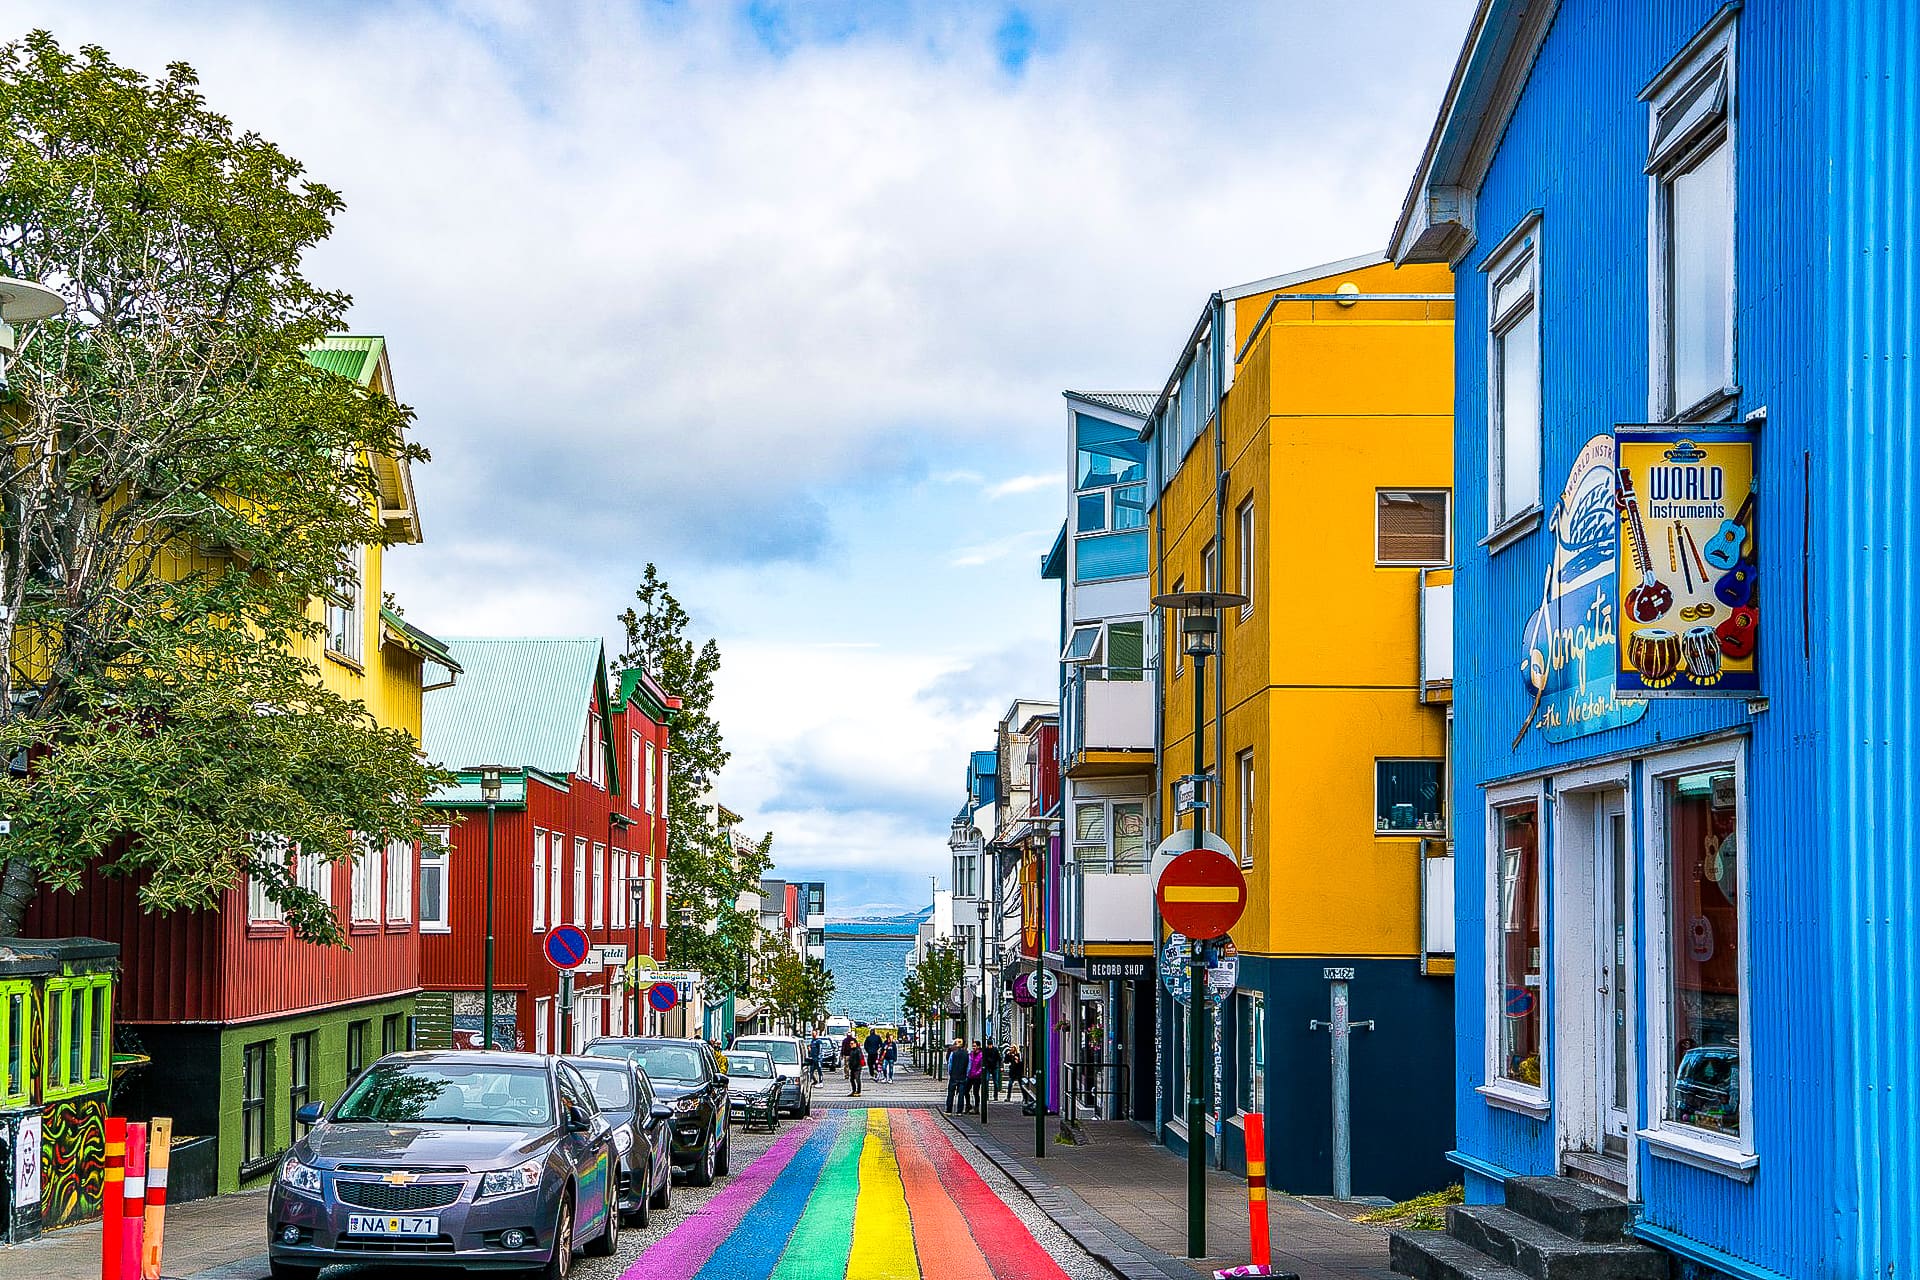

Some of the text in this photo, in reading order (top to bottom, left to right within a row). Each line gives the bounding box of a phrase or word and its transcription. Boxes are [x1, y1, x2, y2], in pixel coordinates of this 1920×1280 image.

[1566, 445, 1615, 496] WORLD INSTR
[1650, 467, 1722, 500] WORLD
[1649, 500, 1725, 519] Instruments
[604, 949, 624, 958] aldi
[1092, 964, 1144, 976] RECORD SHOP
[362, 1218, 432, 1232] NA L71
